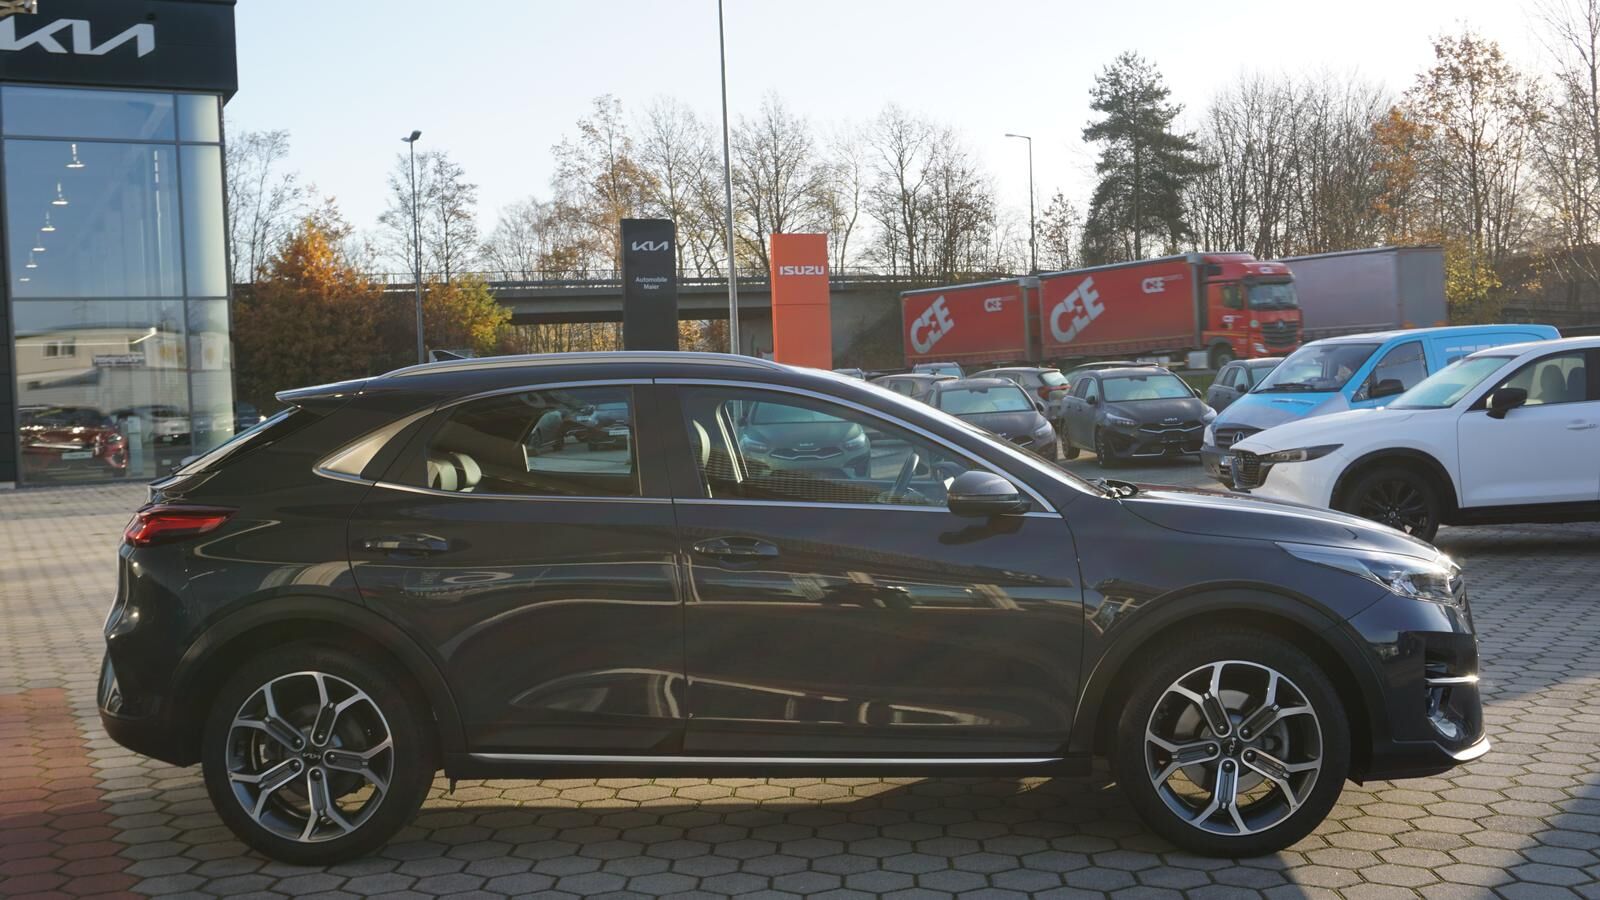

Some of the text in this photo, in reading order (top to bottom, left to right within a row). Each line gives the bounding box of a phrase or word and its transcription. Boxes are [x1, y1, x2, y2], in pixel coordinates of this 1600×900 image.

[0, 16, 155, 58] KIA
[632, 240, 669, 251] KIA
[780, 265, 824, 275] ISUZU
